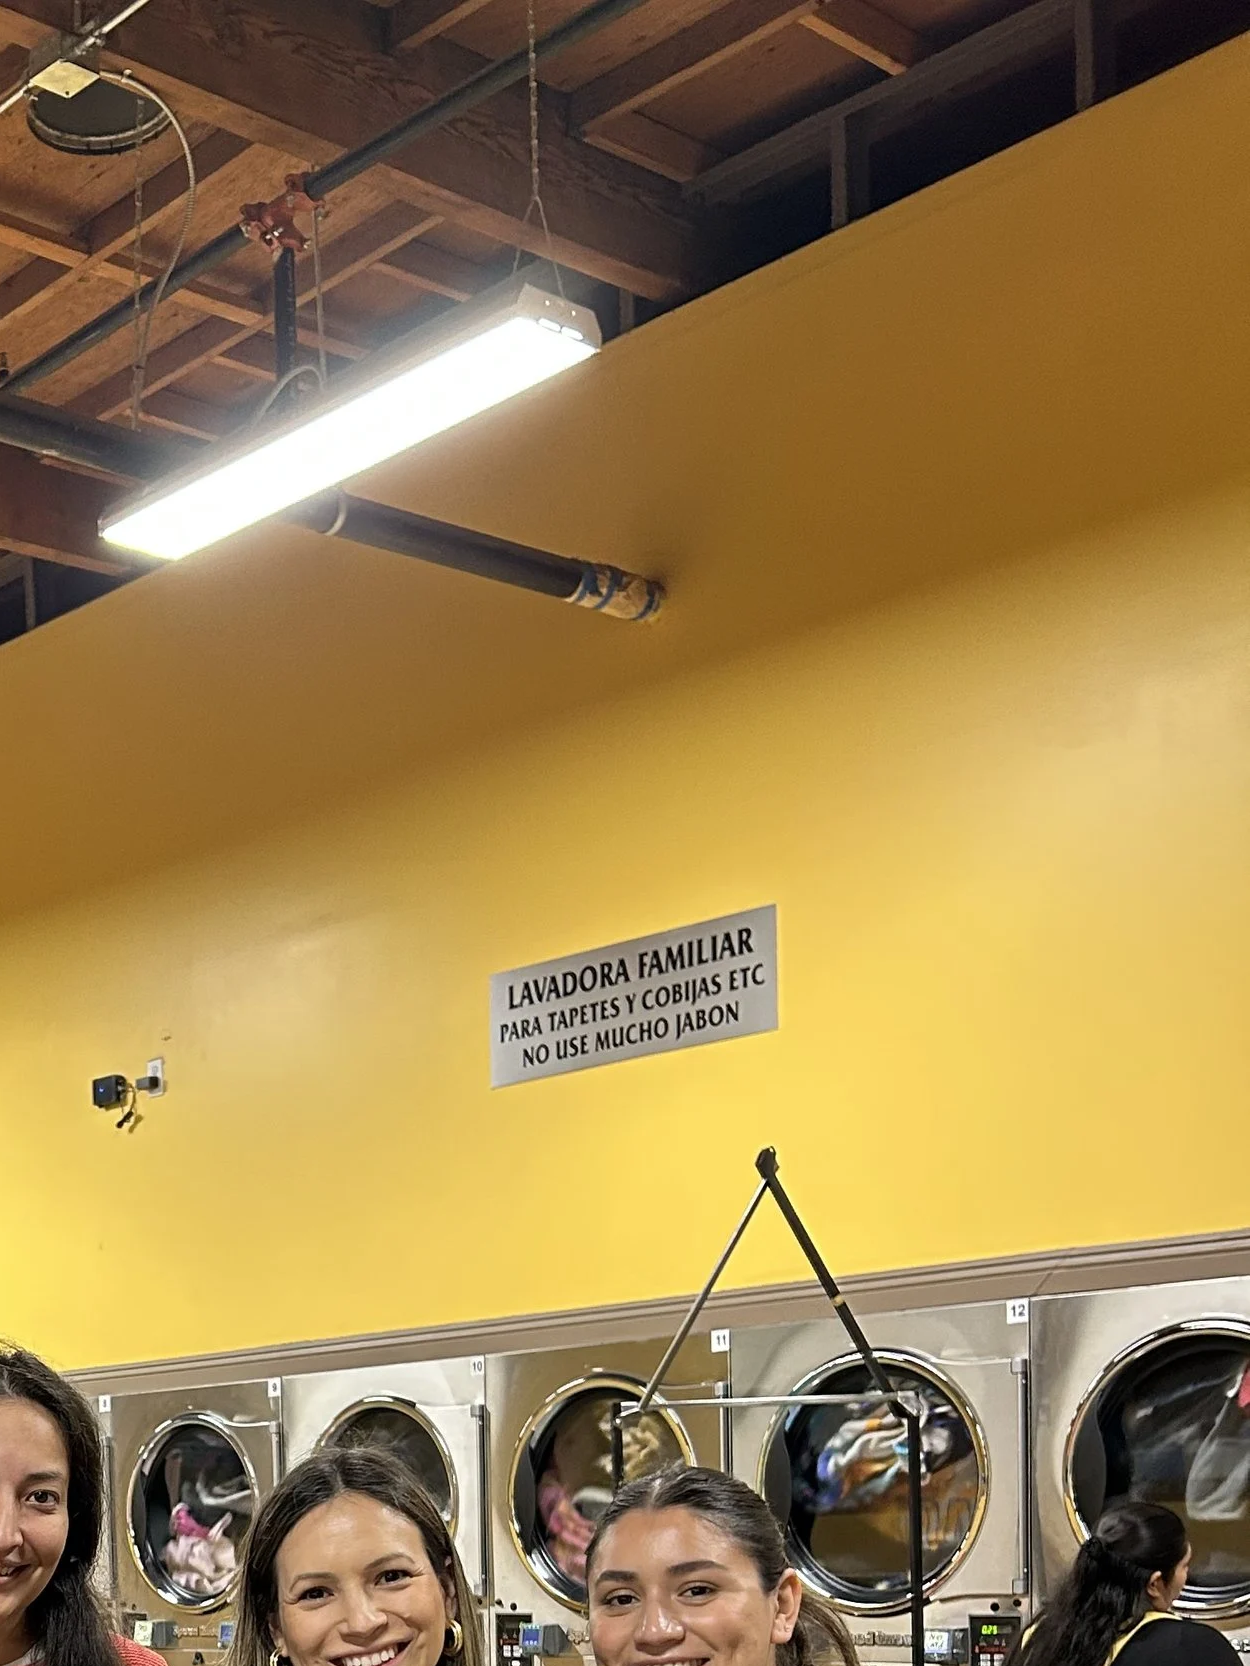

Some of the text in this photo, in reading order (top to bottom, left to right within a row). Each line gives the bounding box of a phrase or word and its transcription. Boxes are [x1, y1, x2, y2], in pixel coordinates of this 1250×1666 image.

[508, 927, 754, 1010] LAVADORA FAMILIAR
[500, 964, 765, 1043] PARA TAPETES Y COBIJAS ETC
[522, 1001, 739, 1068] NO USE MUCHO JABON
[1010, 1305, 1025, 1317] 12
[716, 1335, 728, 1346] 11
[472, 1362, 482, 1371] 10
[272, 1382, 277, 1391] 9
